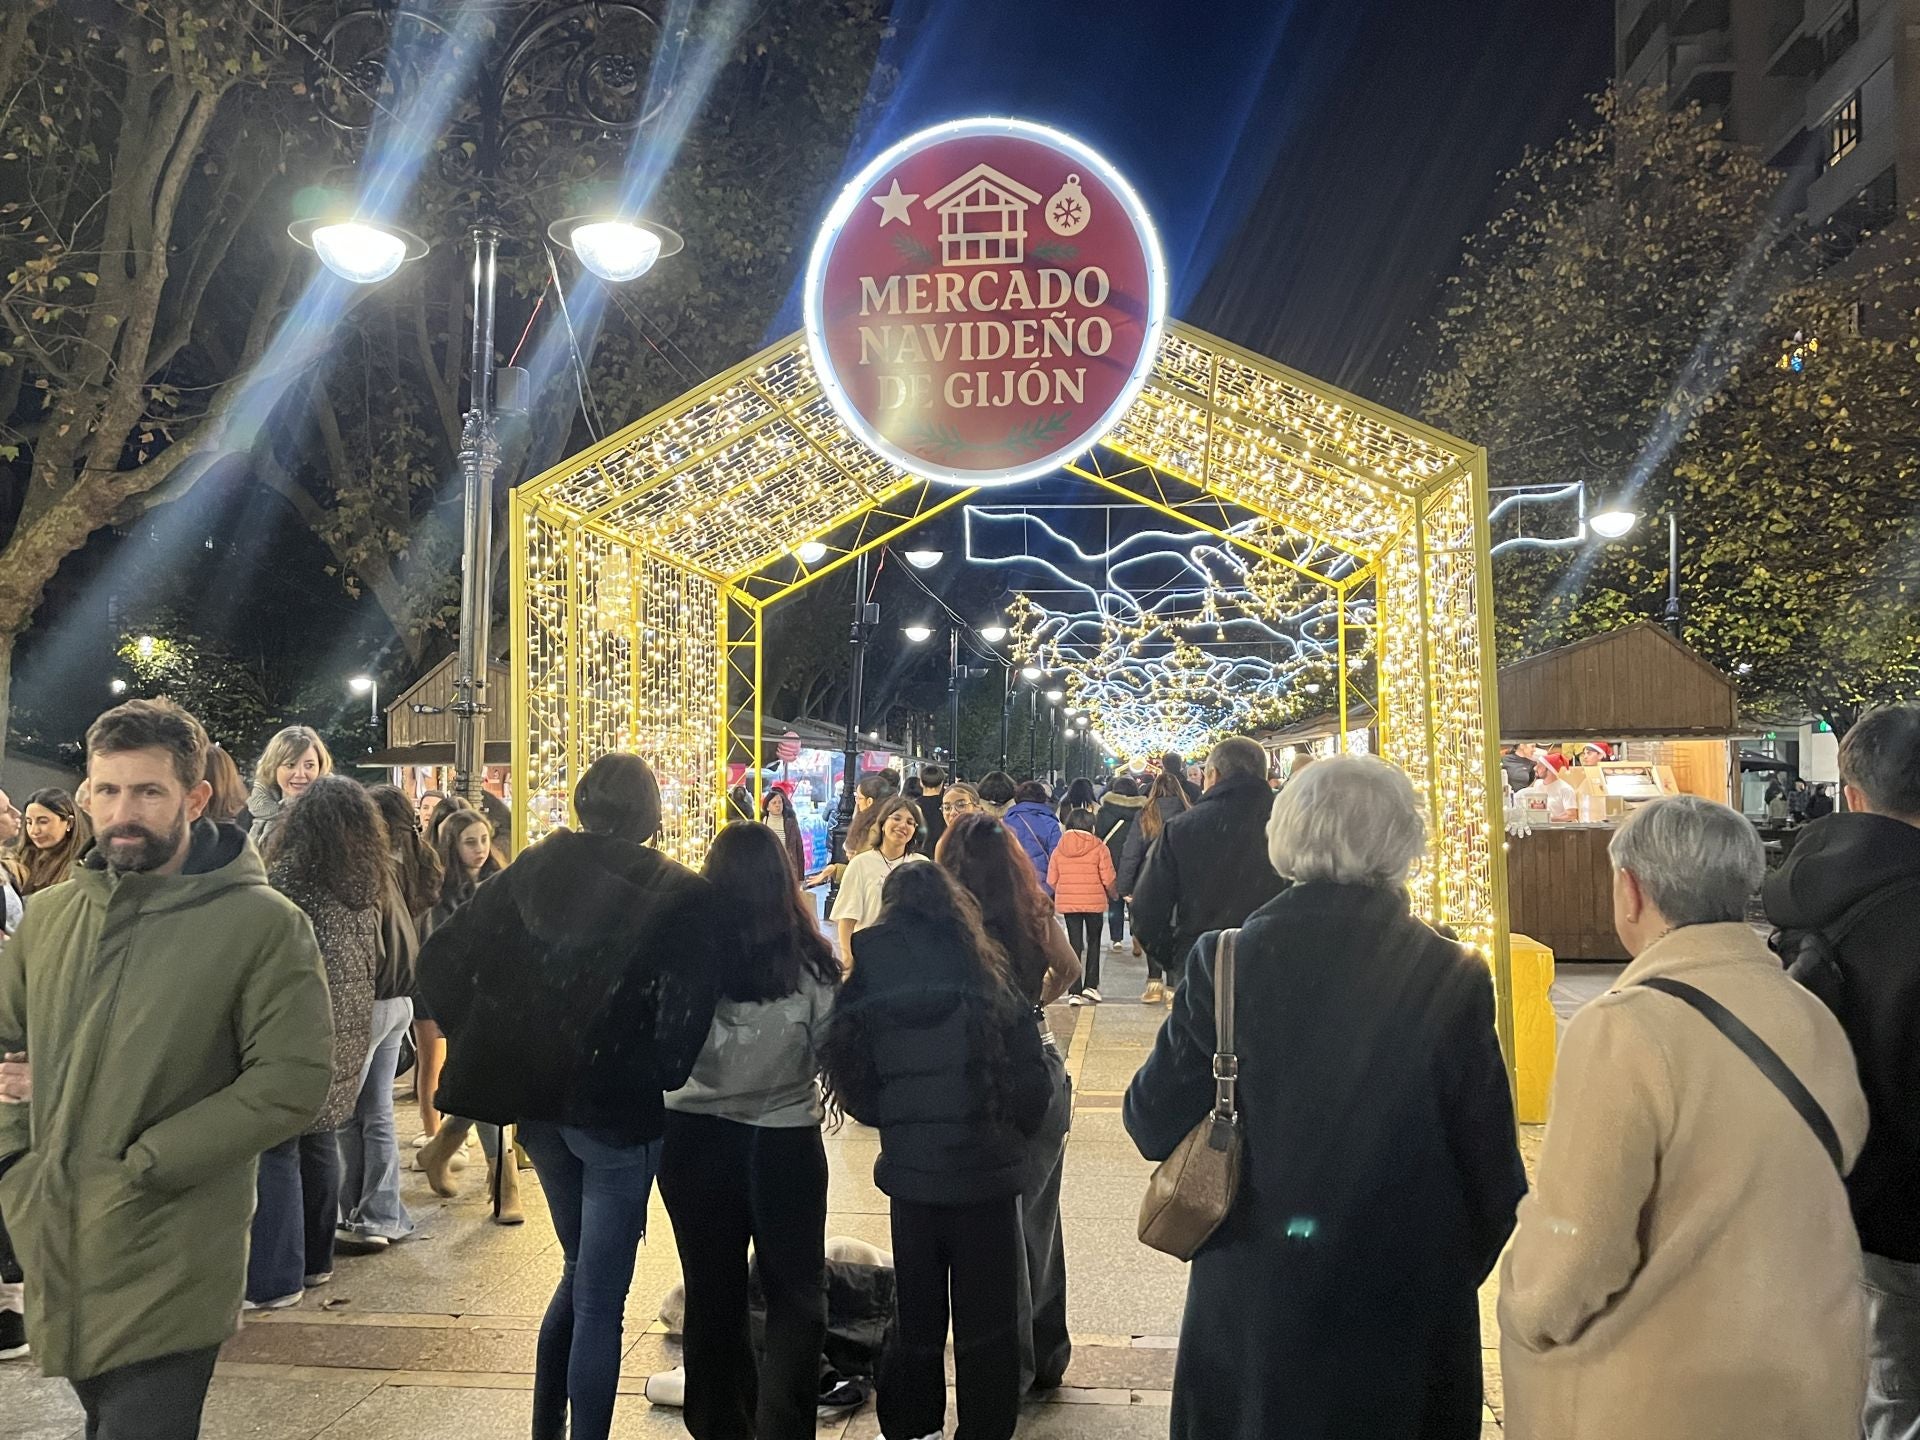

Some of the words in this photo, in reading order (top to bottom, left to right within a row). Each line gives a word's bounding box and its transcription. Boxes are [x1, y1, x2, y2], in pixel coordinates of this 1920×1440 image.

[858, 266, 1110, 316] MERCADO
[858, 311, 1112, 365] NAVIDEÑO
[877, 373, 934, 411] DE
[943, 361, 1087, 408] GIJÓN
